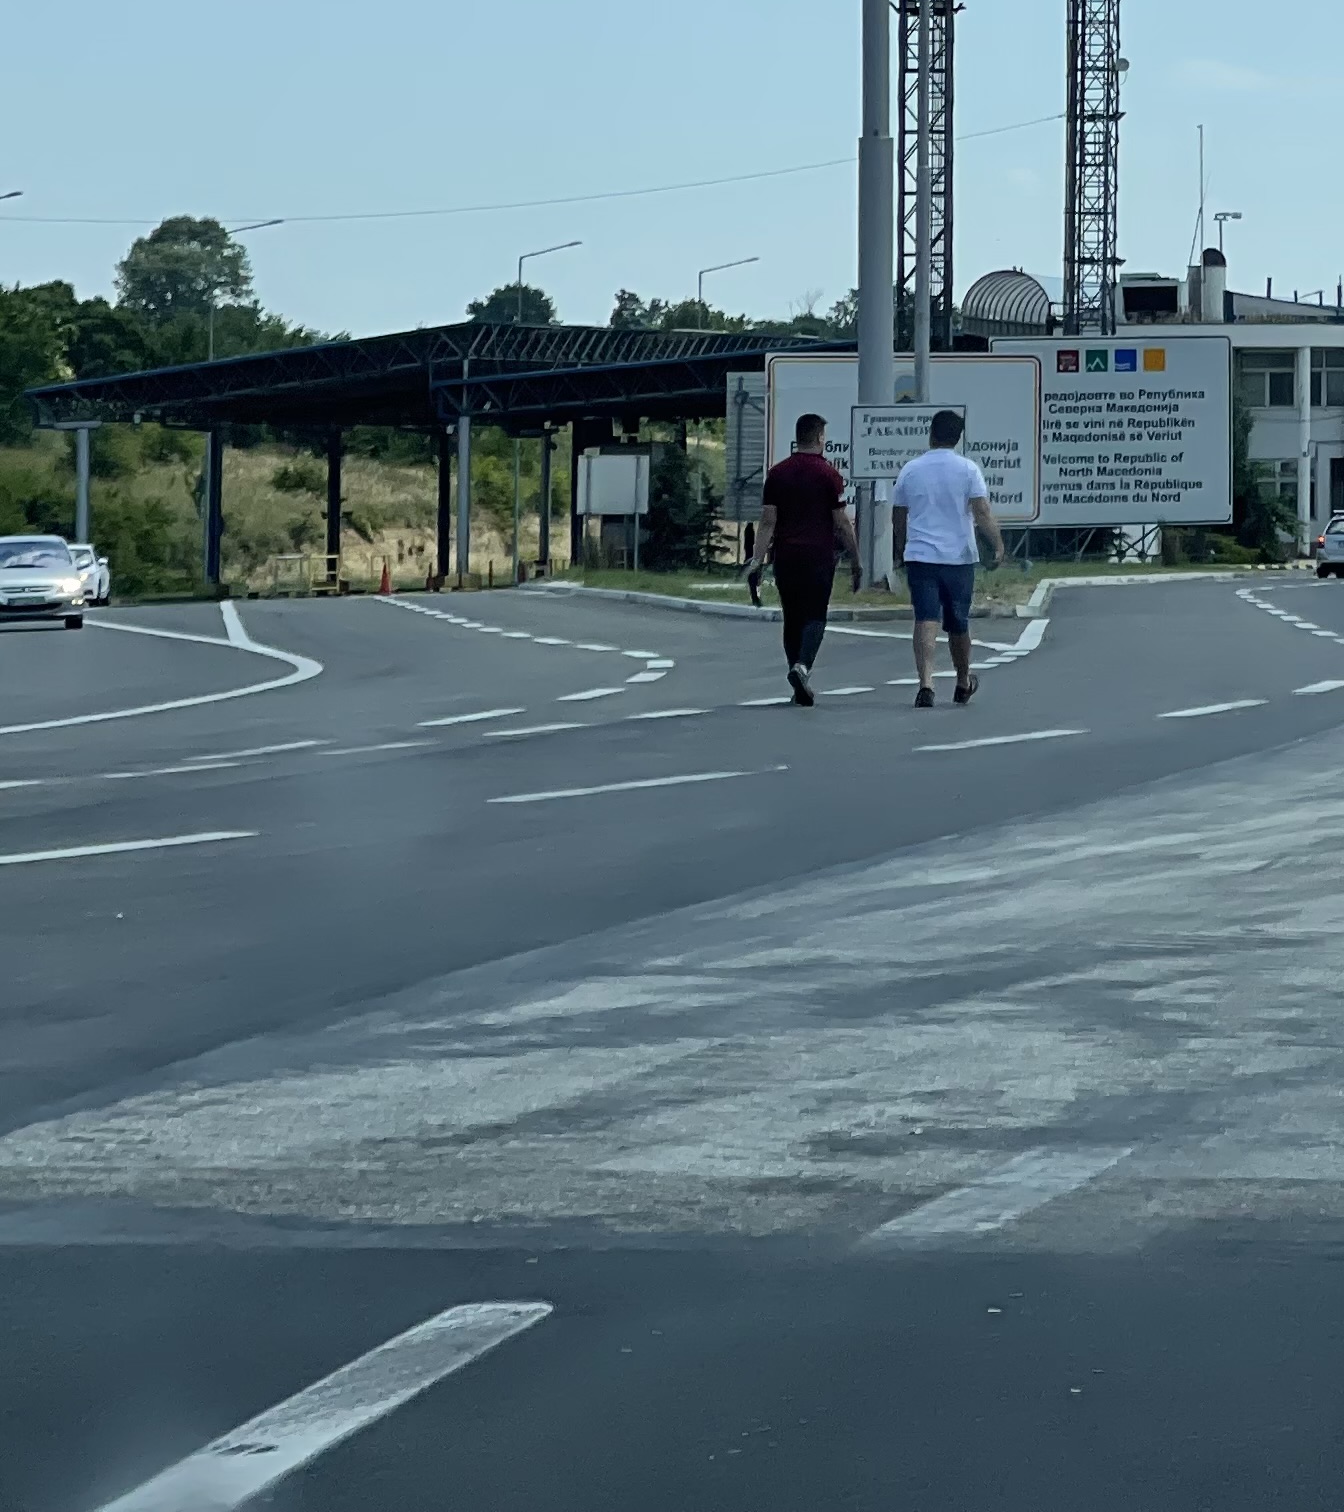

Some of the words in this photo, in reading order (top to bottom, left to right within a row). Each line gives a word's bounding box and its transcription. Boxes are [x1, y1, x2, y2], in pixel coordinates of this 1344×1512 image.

[1044, 391, 1116, 404] редојдовте
[1119, 391, 1135, 400] во
[1138, 389, 1206, 402] Република
[1048, 403, 1103, 416] Северна
[1106, 402, 1180, 415] Македонија
[1042, 419, 1062, 430] irë
[1083, 417, 1105, 429] vini
[1127, 416, 1196, 430] Republikën
[1052, 431, 1126, 445] Maqedonisë
[1146, 430, 1183, 442] Veriut
[967, 438, 1019, 455] донија
[981, 456, 1022, 469] Veriut
[1098, 454, 1110, 464] to
[1113, 452, 1168, 465] Republic
[1171, 451, 1185, 463] of
[1058, 466, 1093, 477] North
[1096, 466, 1163, 477] Macedonia
[1042, 482, 1083, 491] venus
[1086, 480, 1116, 491] dans
[1119, 478, 1131, 490] la
[989, 491, 1023, 504] Nord
[1044, 493, 1059, 504] de
[1132, 491, 1148, 503] du
[1151, 490, 1181, 503] Nord
